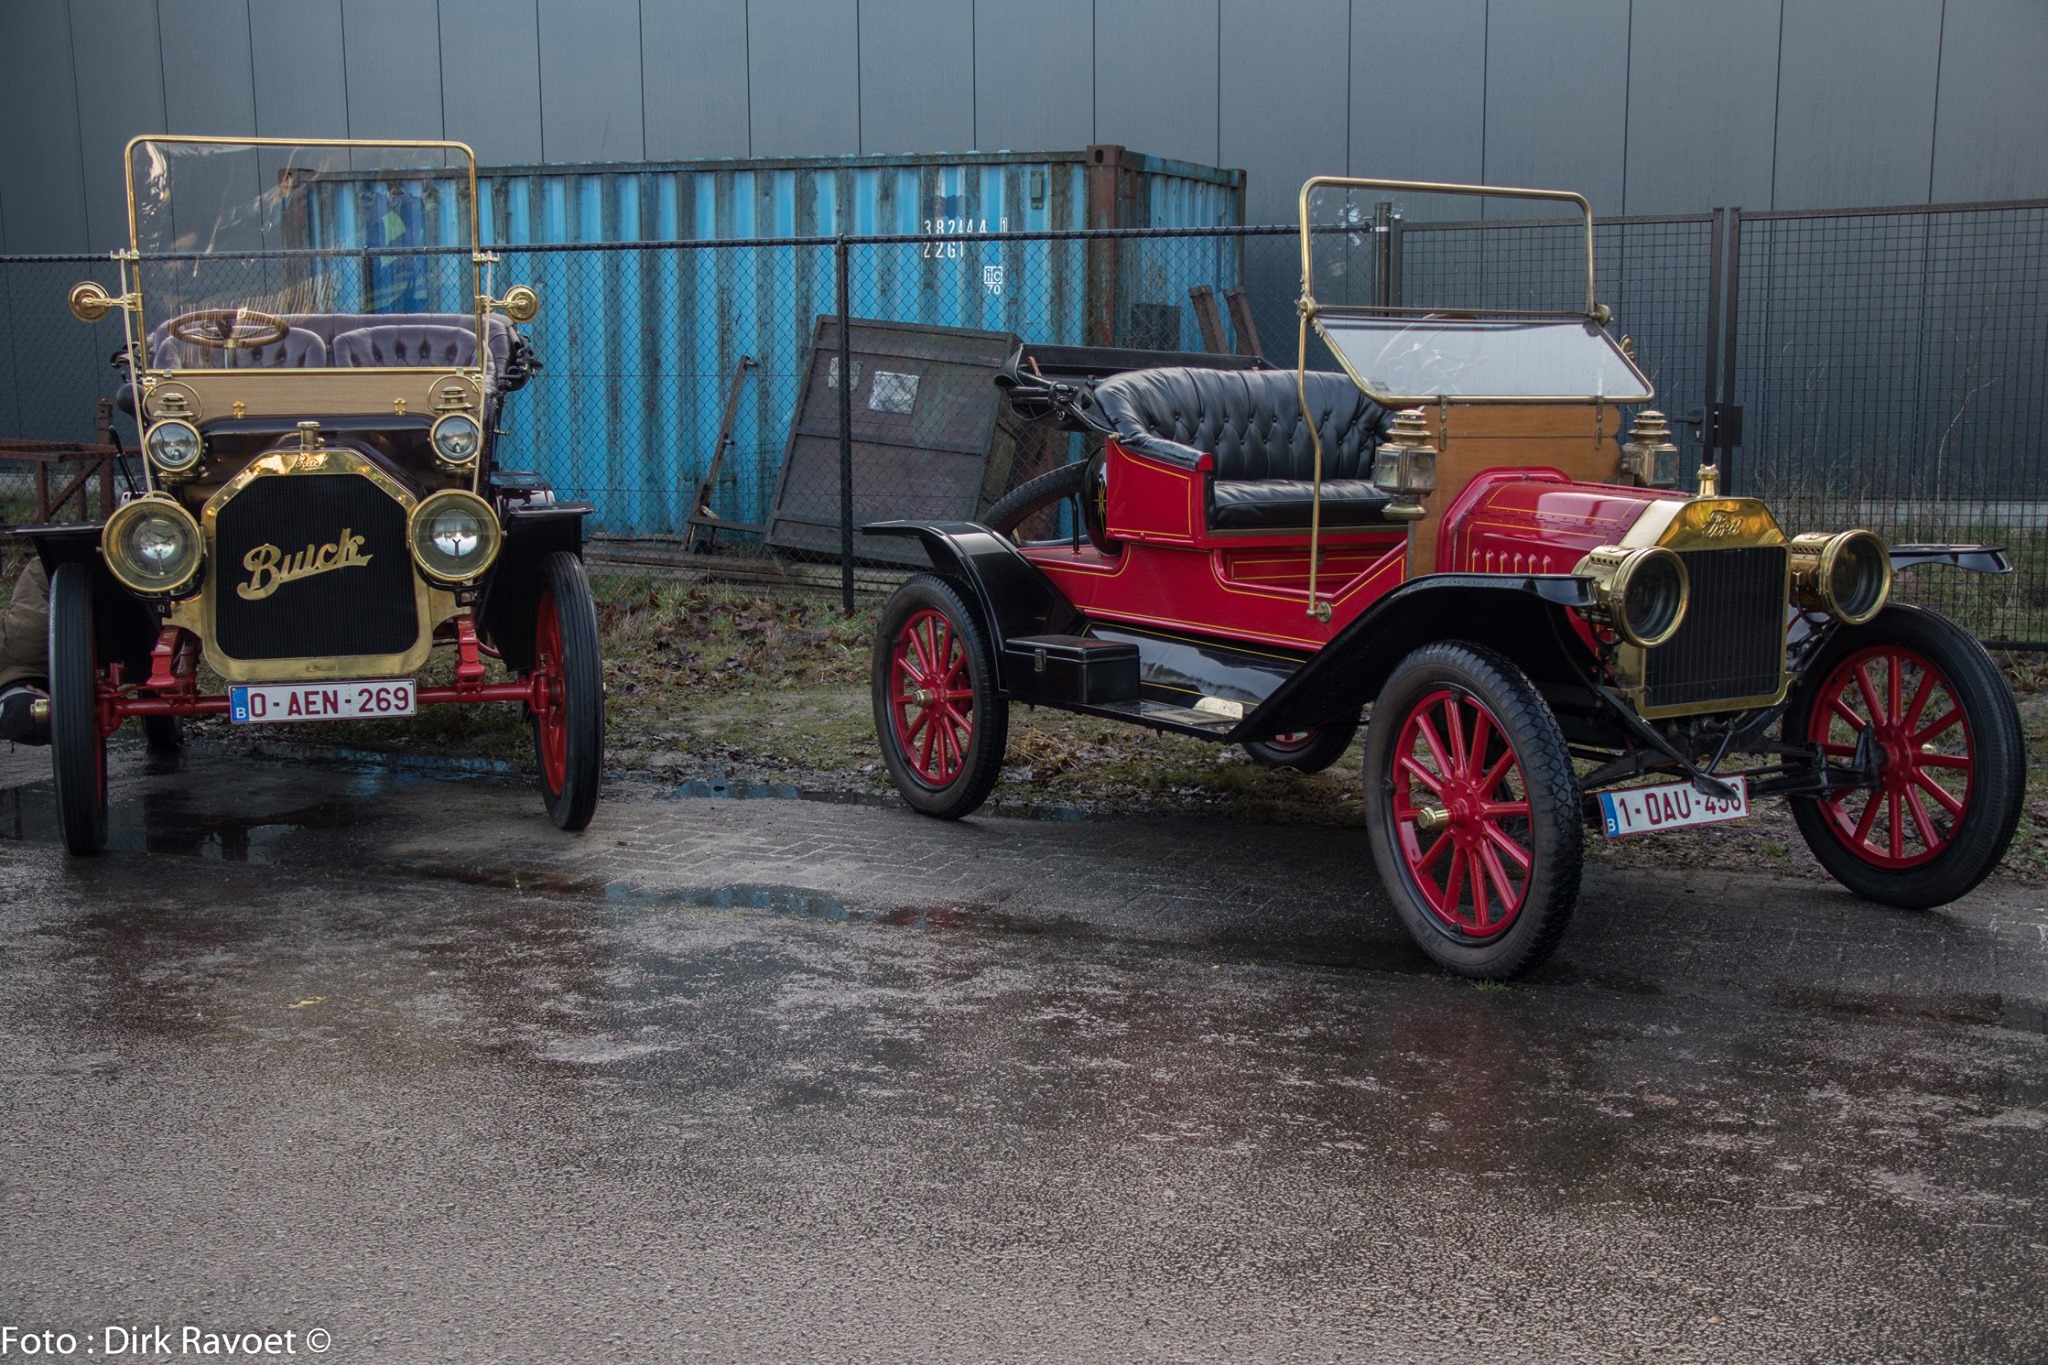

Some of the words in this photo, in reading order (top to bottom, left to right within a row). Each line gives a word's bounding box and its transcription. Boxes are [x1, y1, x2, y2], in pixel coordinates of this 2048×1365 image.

[987, 284, 1001, 295] 70
[237, 528, 374, 600] Buick
[236, 707, 247, 719] B
[1607, 818, 1616, 832] B
